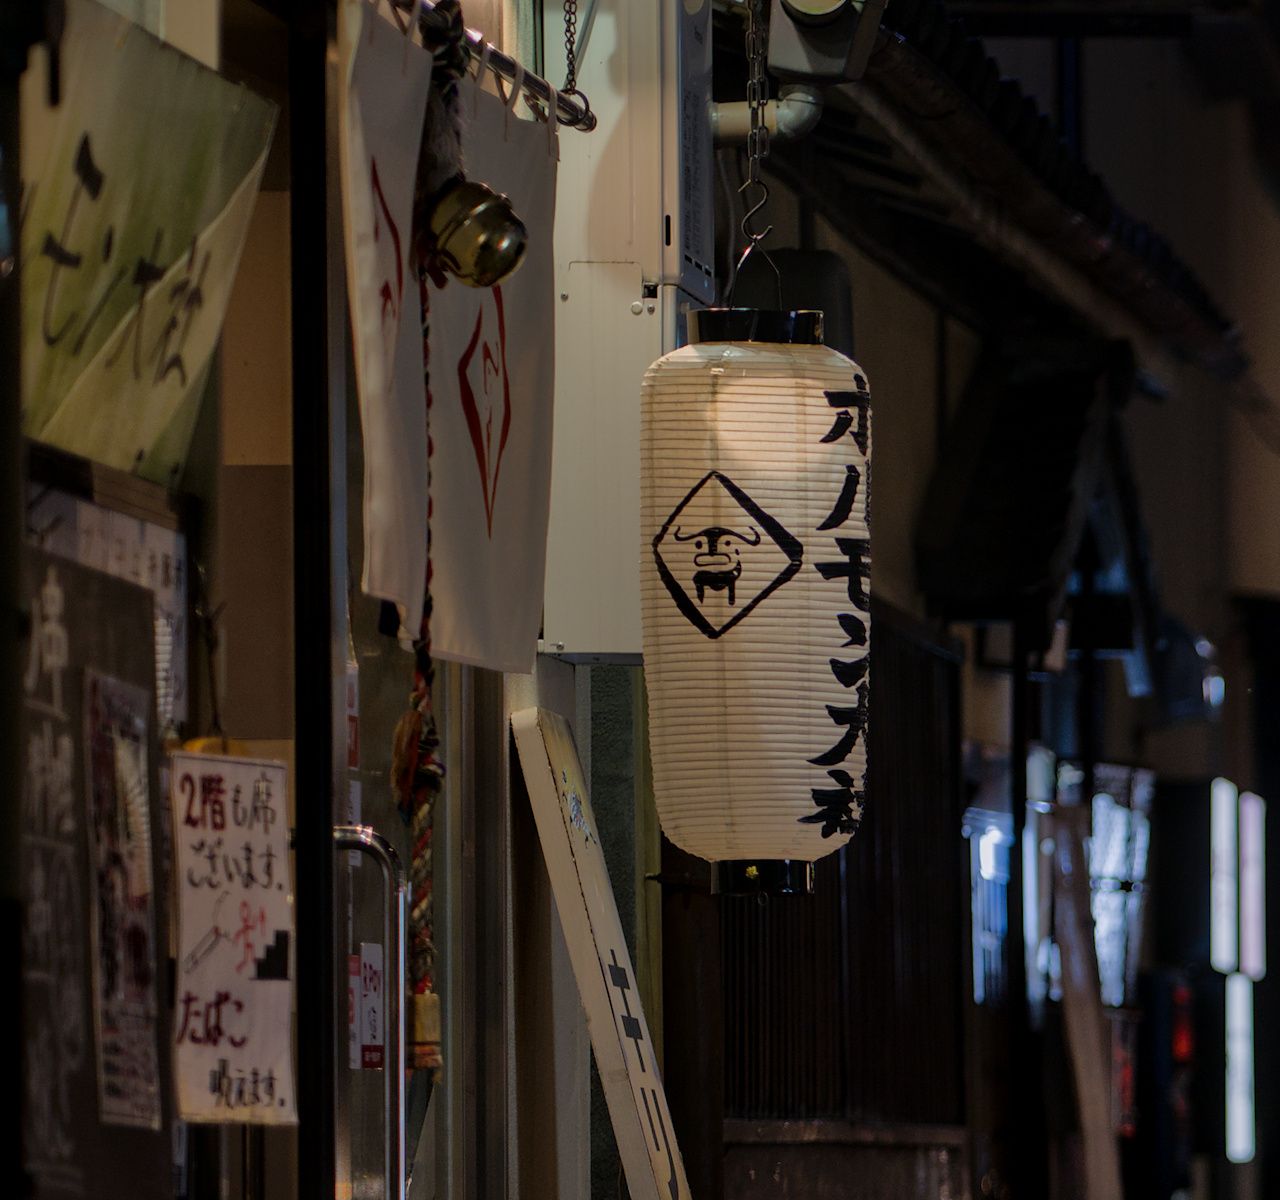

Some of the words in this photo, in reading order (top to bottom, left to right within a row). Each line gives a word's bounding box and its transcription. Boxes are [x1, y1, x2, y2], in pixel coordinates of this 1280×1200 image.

[180, 772, 277, 833] 2階も席
[177, 991, 246, 1048] たばこ
